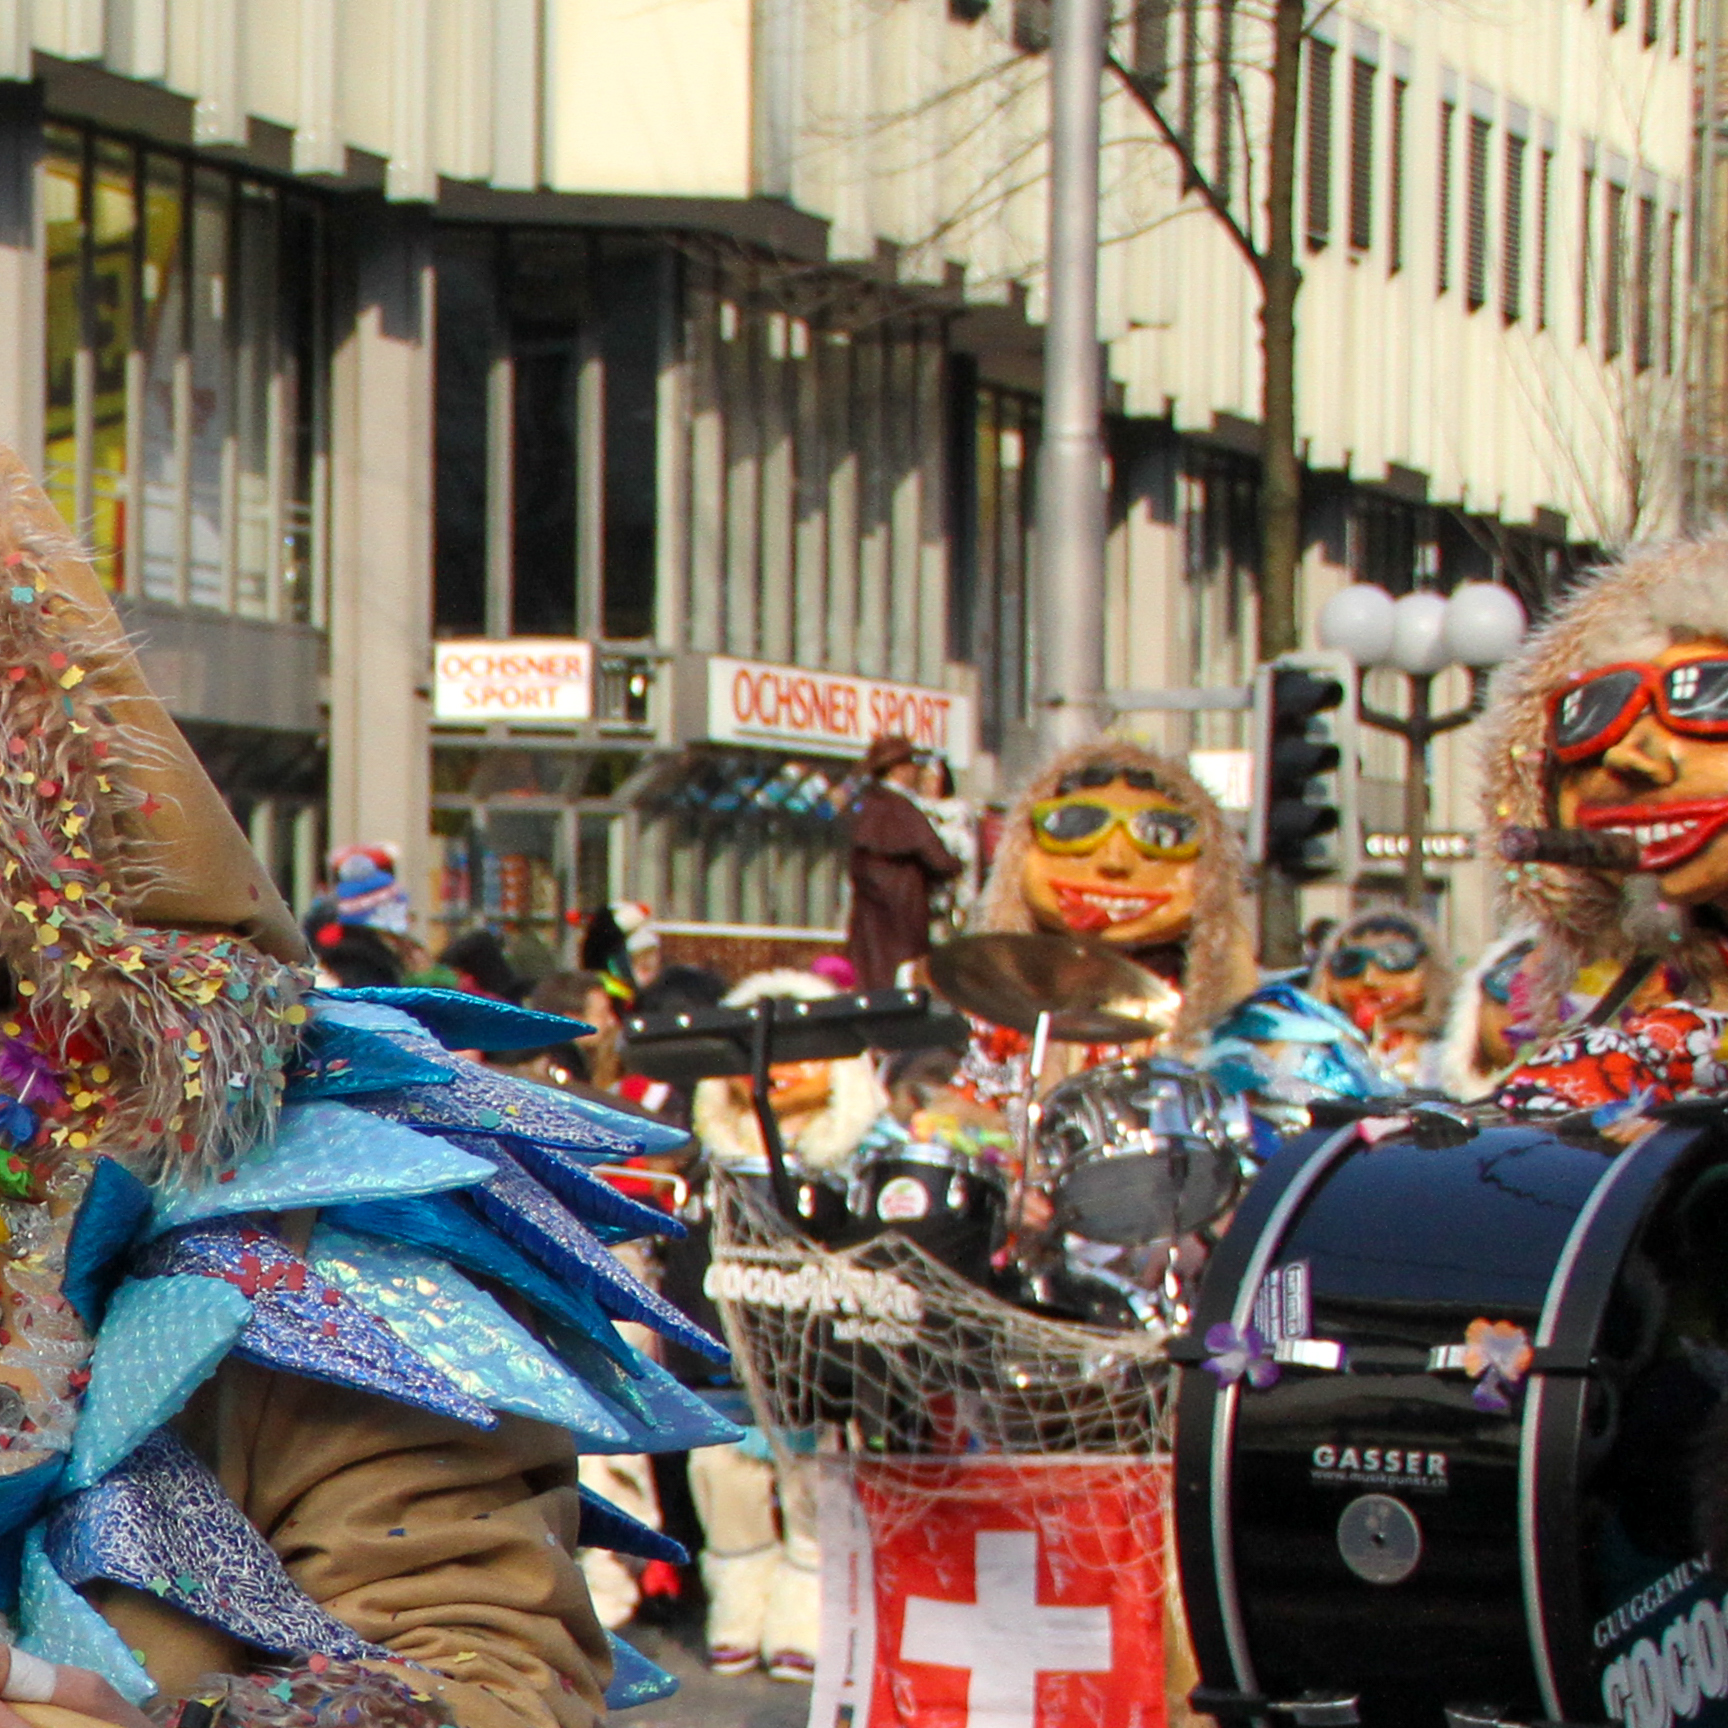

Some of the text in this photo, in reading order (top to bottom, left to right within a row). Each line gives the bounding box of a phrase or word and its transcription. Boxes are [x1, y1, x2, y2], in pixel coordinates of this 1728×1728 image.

[441, 654, 582, 679] OCHSNER
[464, 686, 559, 709] SPORT
[732, 669, 950, 748] OCHSNER SPORT
[1312, 1444, 1447, 1476] GASSER
